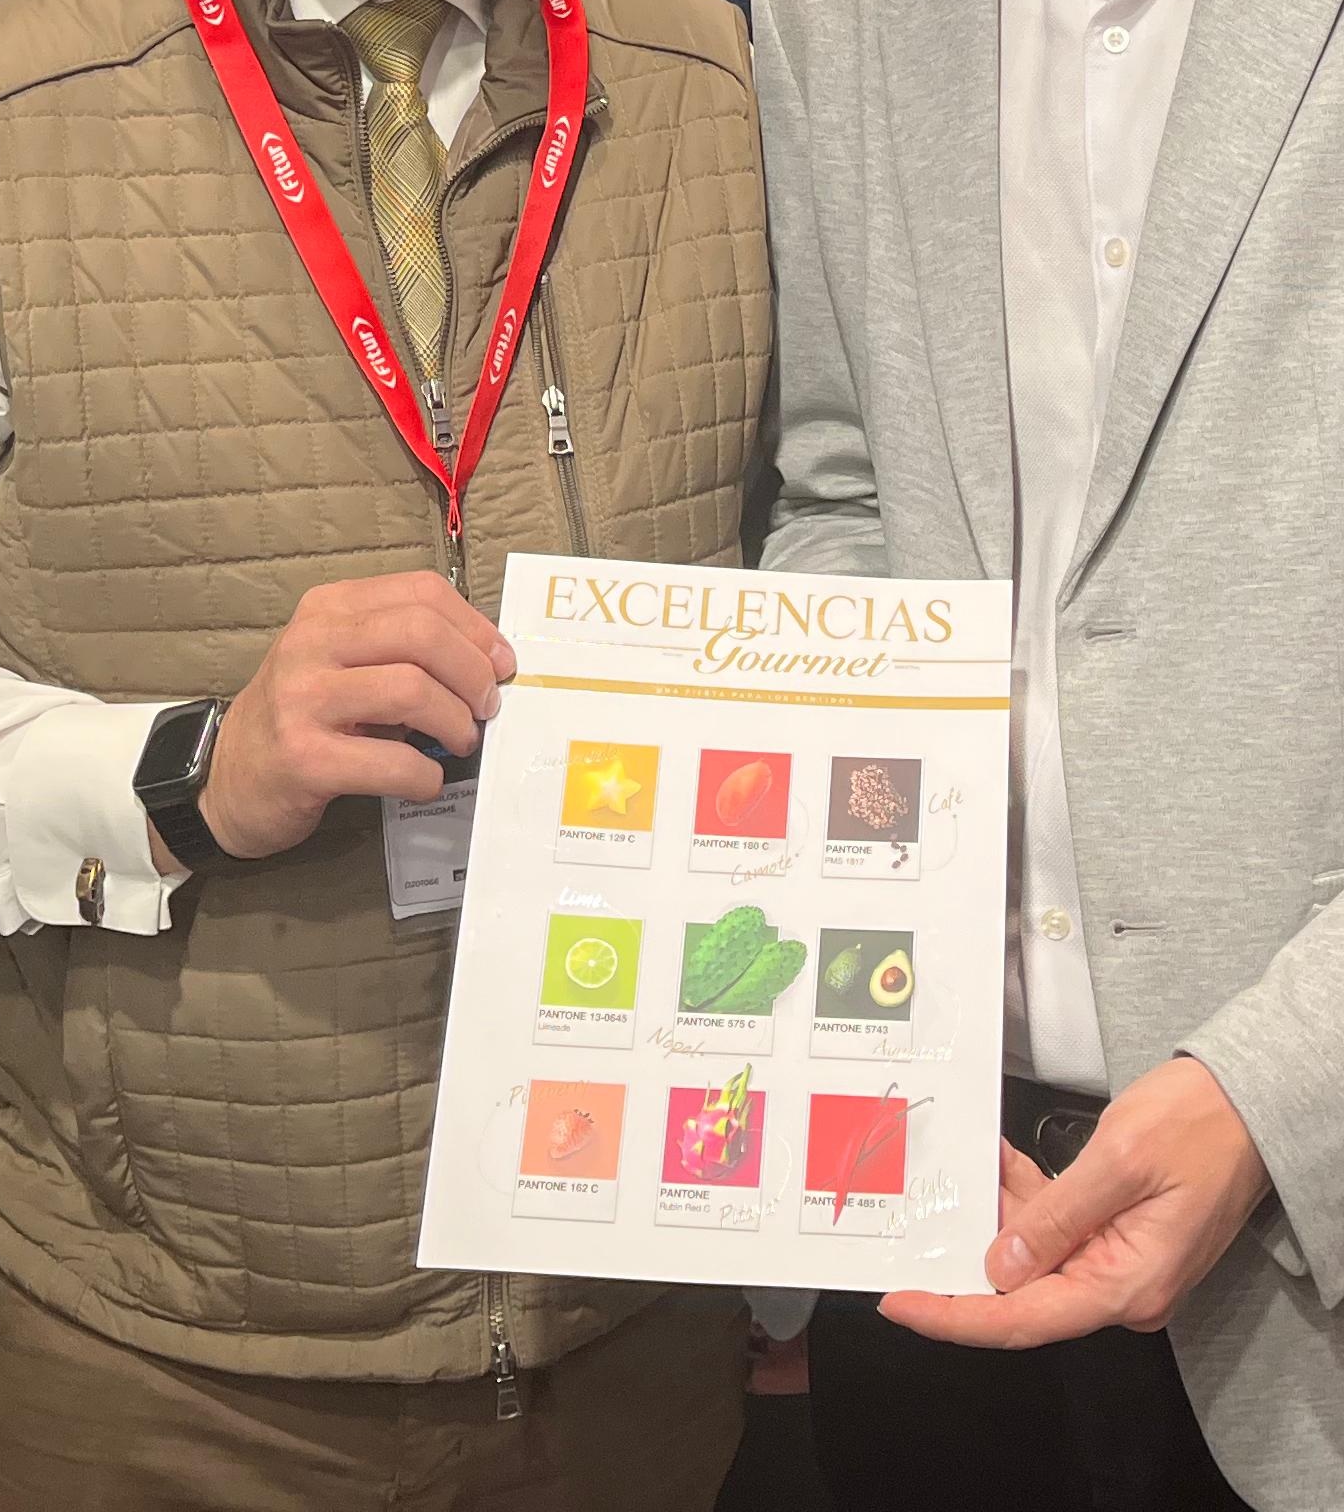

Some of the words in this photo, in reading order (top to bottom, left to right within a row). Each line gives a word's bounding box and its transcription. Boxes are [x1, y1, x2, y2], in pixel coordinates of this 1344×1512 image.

[543, 126, 569, 179] Fitur
[266, 141, 301, 194] Fitur
[357, 327, 393, 378] Fitur
[491, 319, 514, 374] Fitur
[544, 574, 953, 643] EXCELENCIAS
[693, 617, 891, 678] Gourmet
[559, 830, 605, 841] PANTONE
[628, 835, 635, 843] C
[693, 839, 740, 849] PANTONE
[762, 842, 769, 850] C
[826, 845, 872, 854] PANTONE
[539, 1010, 587, 1021] PANTONE
[677, 1017, 724, 1027] PANTONE
[748, 1020, 756, 1029] C
[813, 1022, 861, 1033] PANTONE
[518, 1180, 567, 1191] PANTONE
[591, 1184, 599, 1193] C
[660, 1188, 710, 1199] PANTONE
[879, 1200, 886, 1208] C
